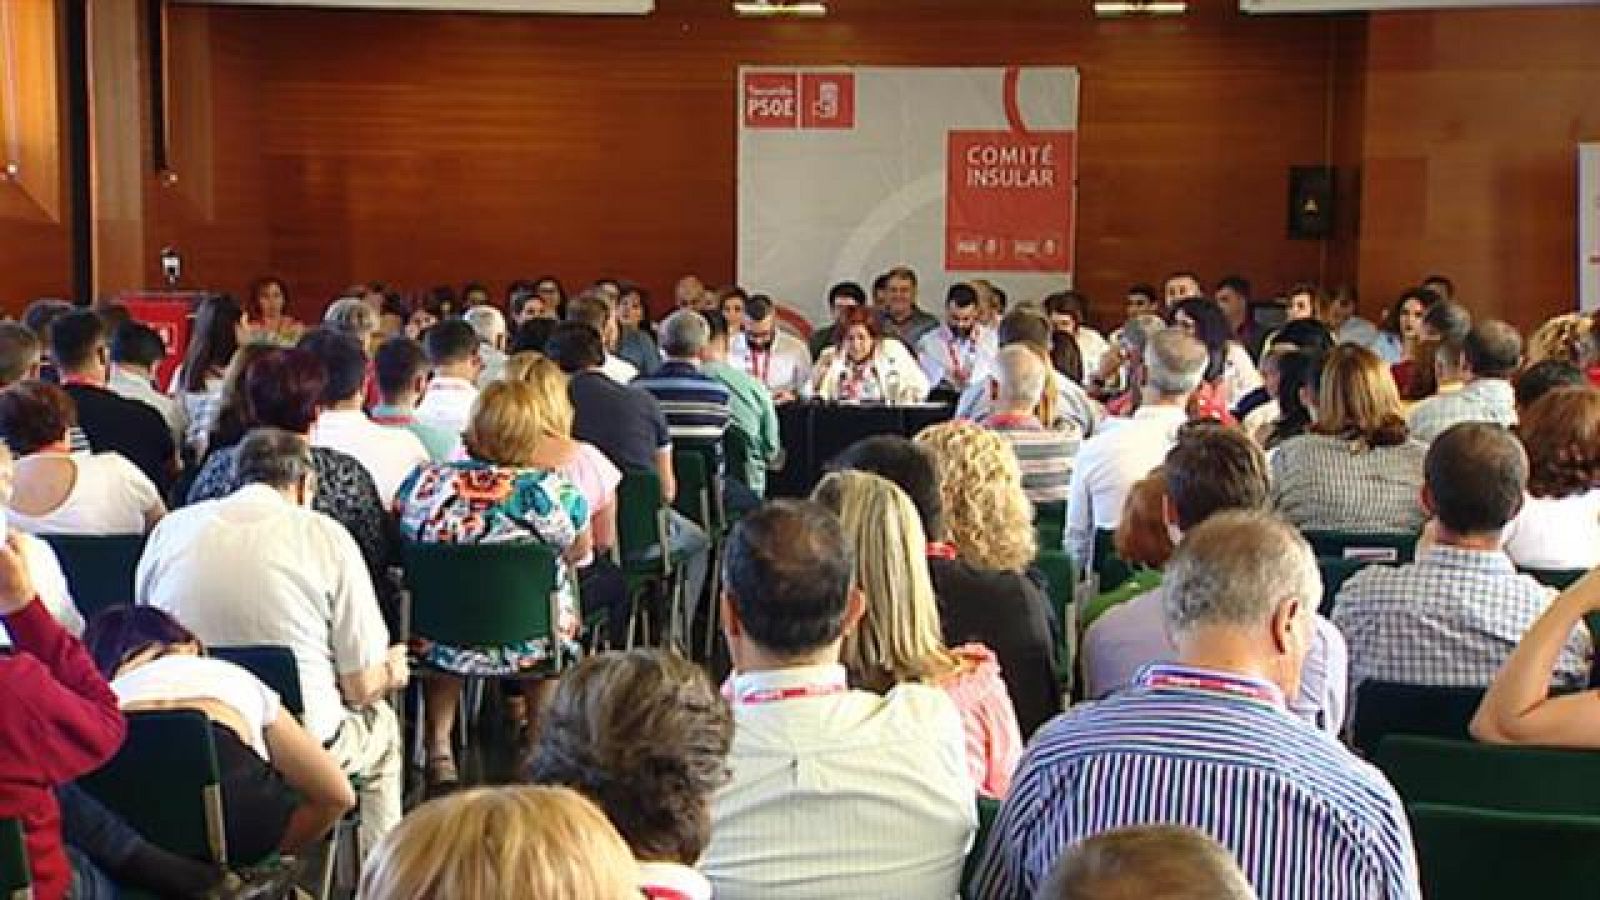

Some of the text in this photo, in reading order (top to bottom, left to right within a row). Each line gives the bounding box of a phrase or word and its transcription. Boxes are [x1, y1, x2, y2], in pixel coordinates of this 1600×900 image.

[747, 99, 794, 117] PSOE
[966, 143, 1053, 166] COMITÉ
[966, 168, 1054, 188] INSULAR
